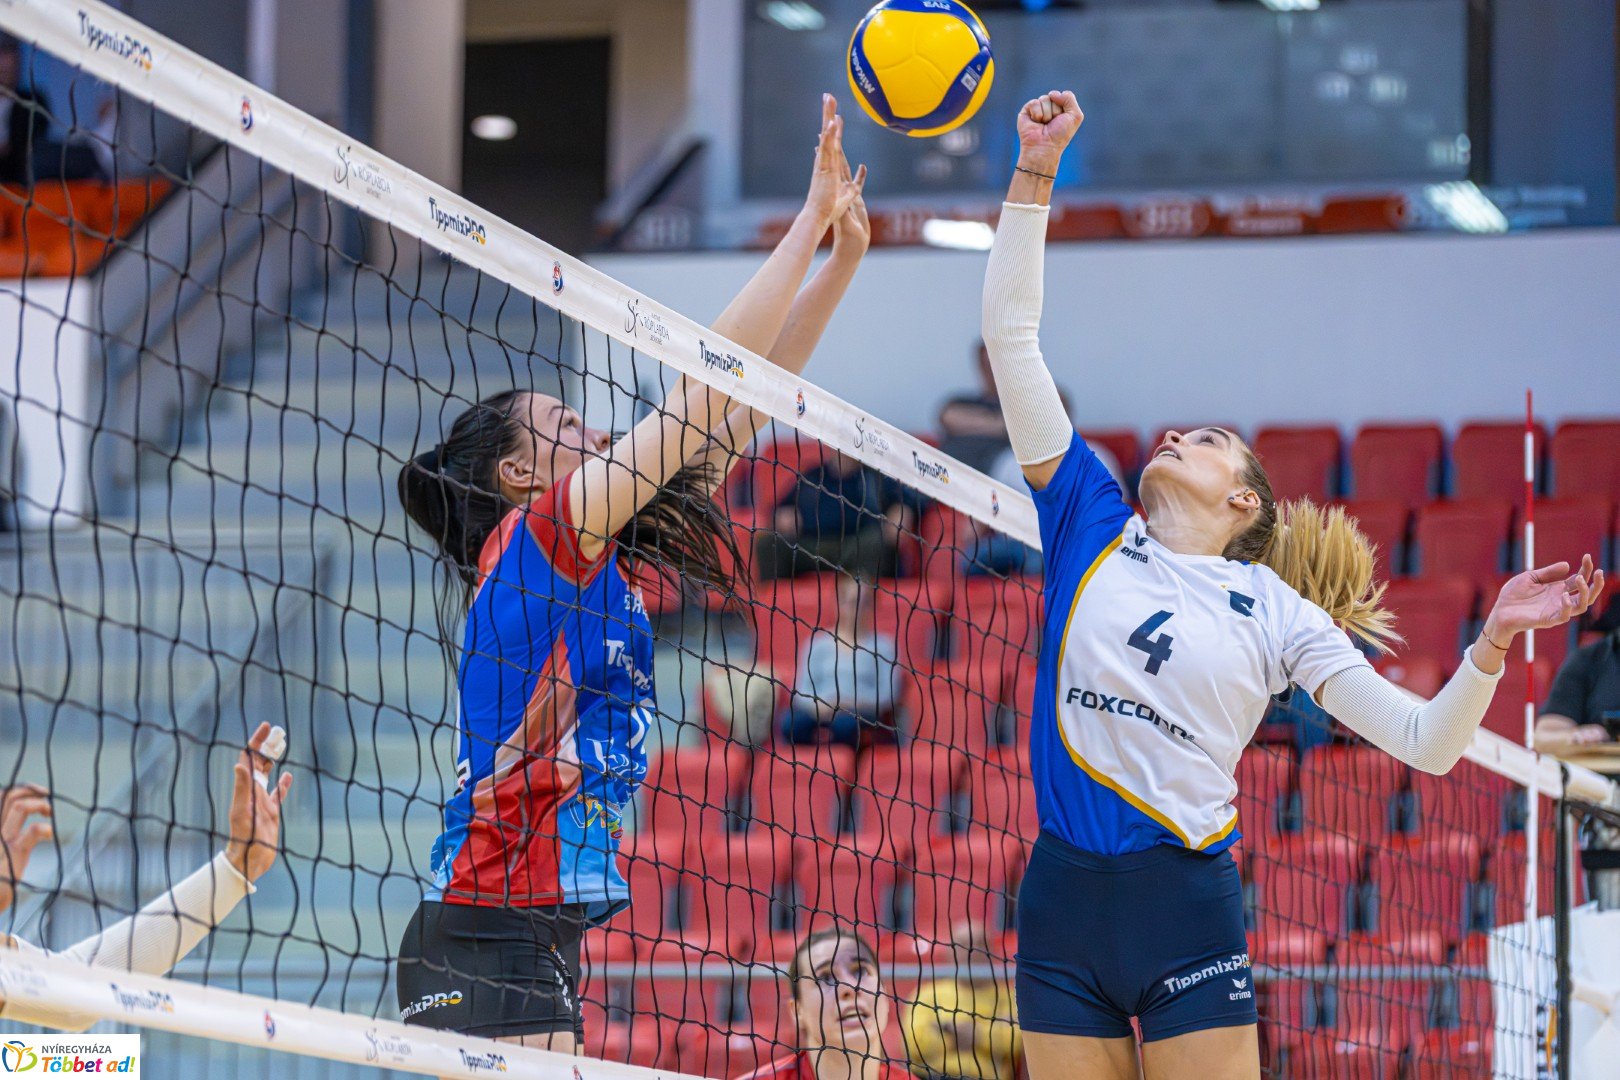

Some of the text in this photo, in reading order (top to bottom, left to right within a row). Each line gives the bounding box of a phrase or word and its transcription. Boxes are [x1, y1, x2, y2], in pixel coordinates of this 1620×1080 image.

[78, 10, 153, 70] TippmixPRO
[428, 196, 486, 246] TippmixPRO
[699, 339, 745, 379] TippmixPRO
[912, 450, 950, 484] TippmixPRO
[1120, 546, 1148, 564] erima
[1126, 609, 1175, 676] 4
[1229, 990, 1252, 1001] erima
[459, 1048, 507, 1072] TippmixPRO
